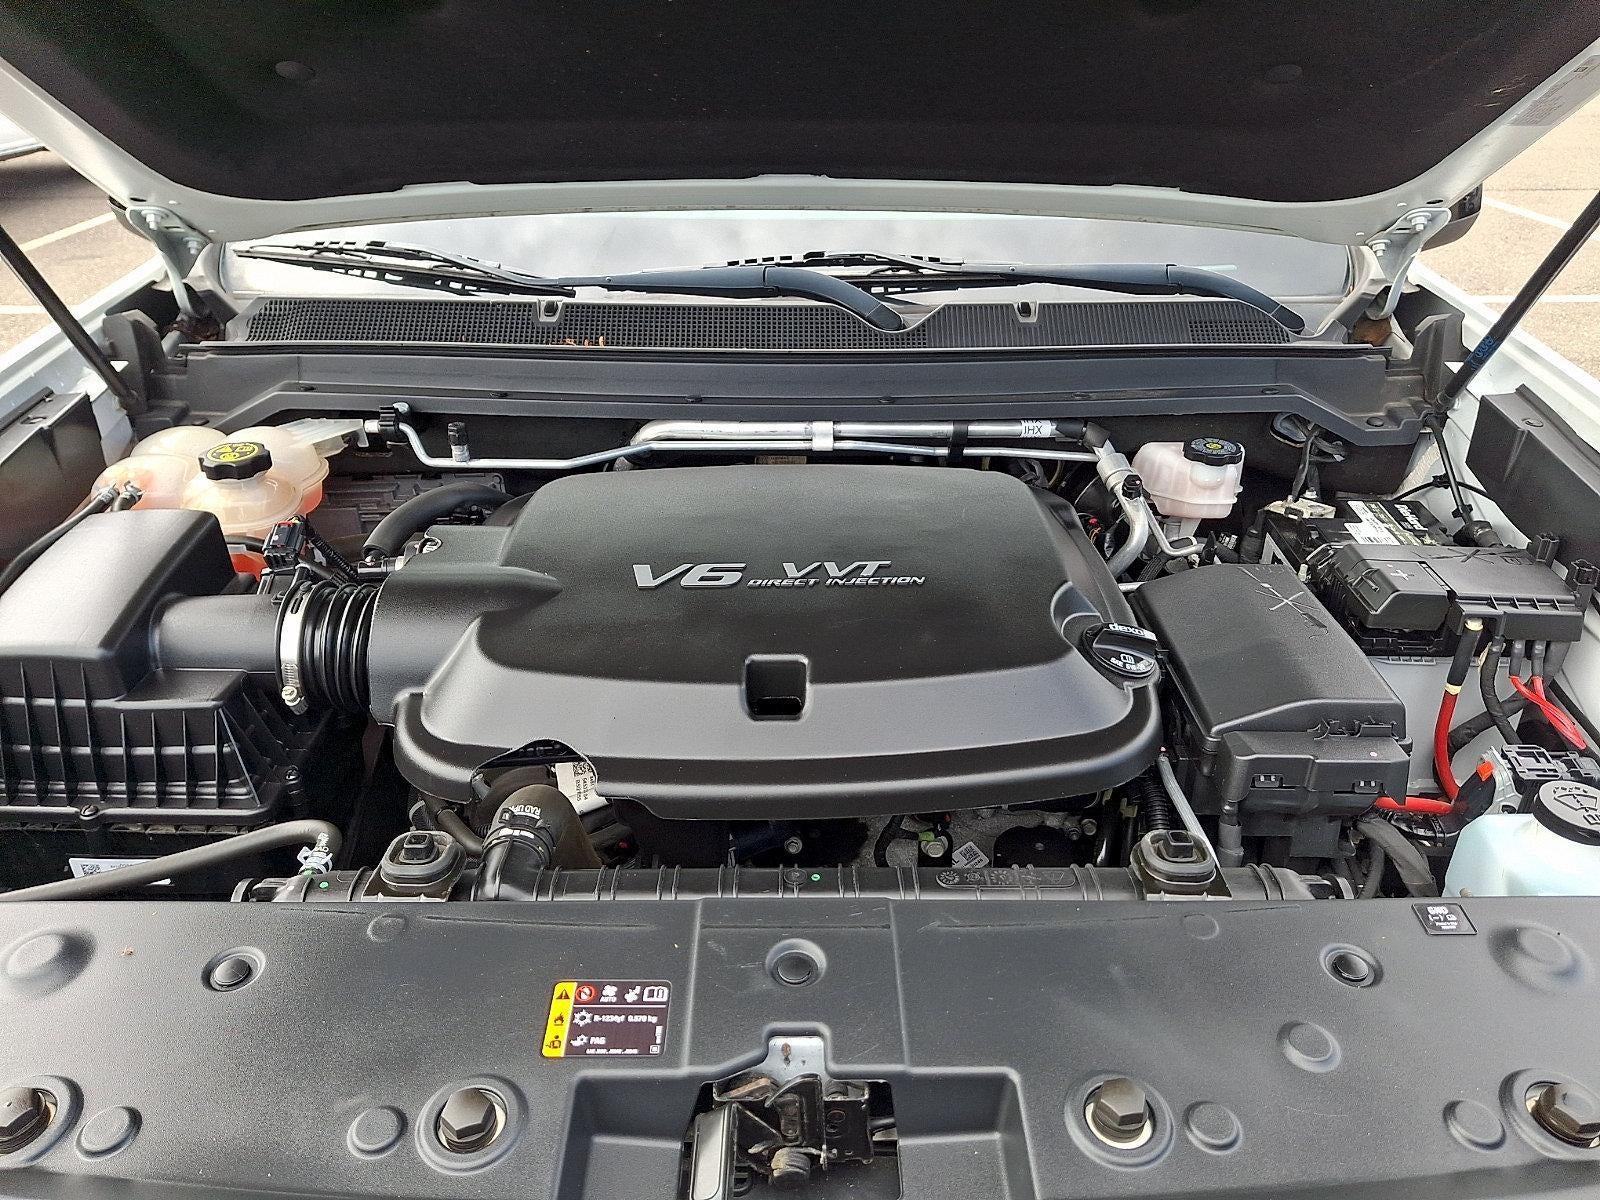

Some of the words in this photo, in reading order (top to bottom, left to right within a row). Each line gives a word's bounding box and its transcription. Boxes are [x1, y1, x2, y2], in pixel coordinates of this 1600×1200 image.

[632, 563, 747, 588] V6
[782, 560, 892, 577] VVT
[747, 577, 820, 587] DIRECT
[824, 576, 926, 586] INJECTION
[525, 804, 541, 815] RAD
